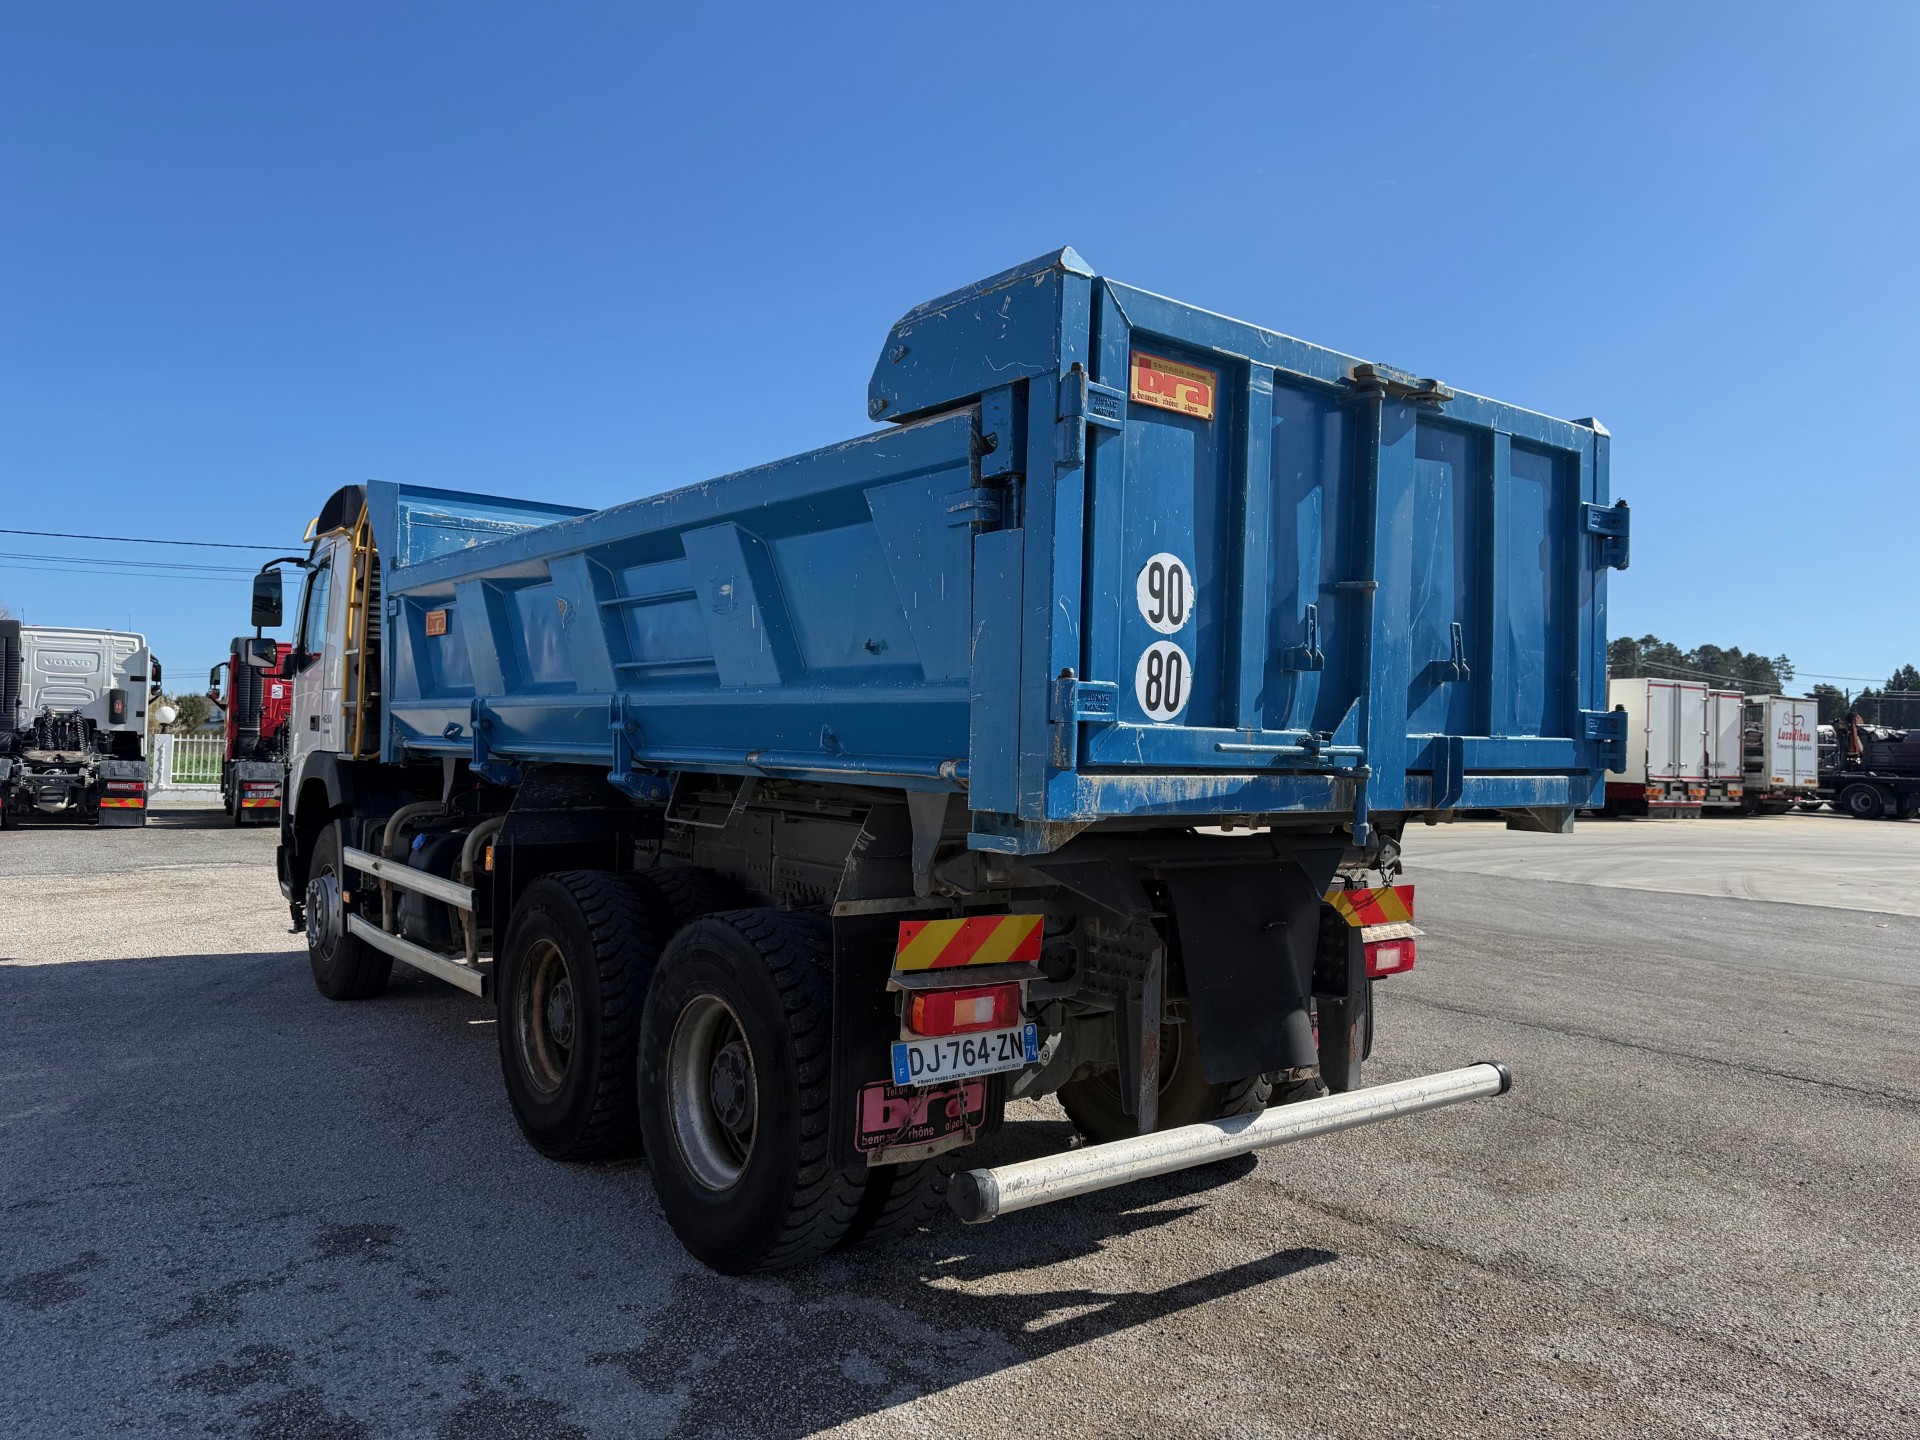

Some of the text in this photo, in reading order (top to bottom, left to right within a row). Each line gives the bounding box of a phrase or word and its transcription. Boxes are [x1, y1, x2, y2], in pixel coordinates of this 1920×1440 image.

[1148, 561, 1184, 626] 90
[43, 658, 93, 667] VOLVO
[1145, 649, 1182, 713] 80
[909, 1031, 1024, 1077] DJ-764-ZN
[1025, 1044, 1036, 1058] 74
[899, 1067, 905, 1077] F
[863, 1083, 983, 1133] bra
[908, 1125, 935, 1139] rhône
[945, 1118, 964, 1131] alpes
